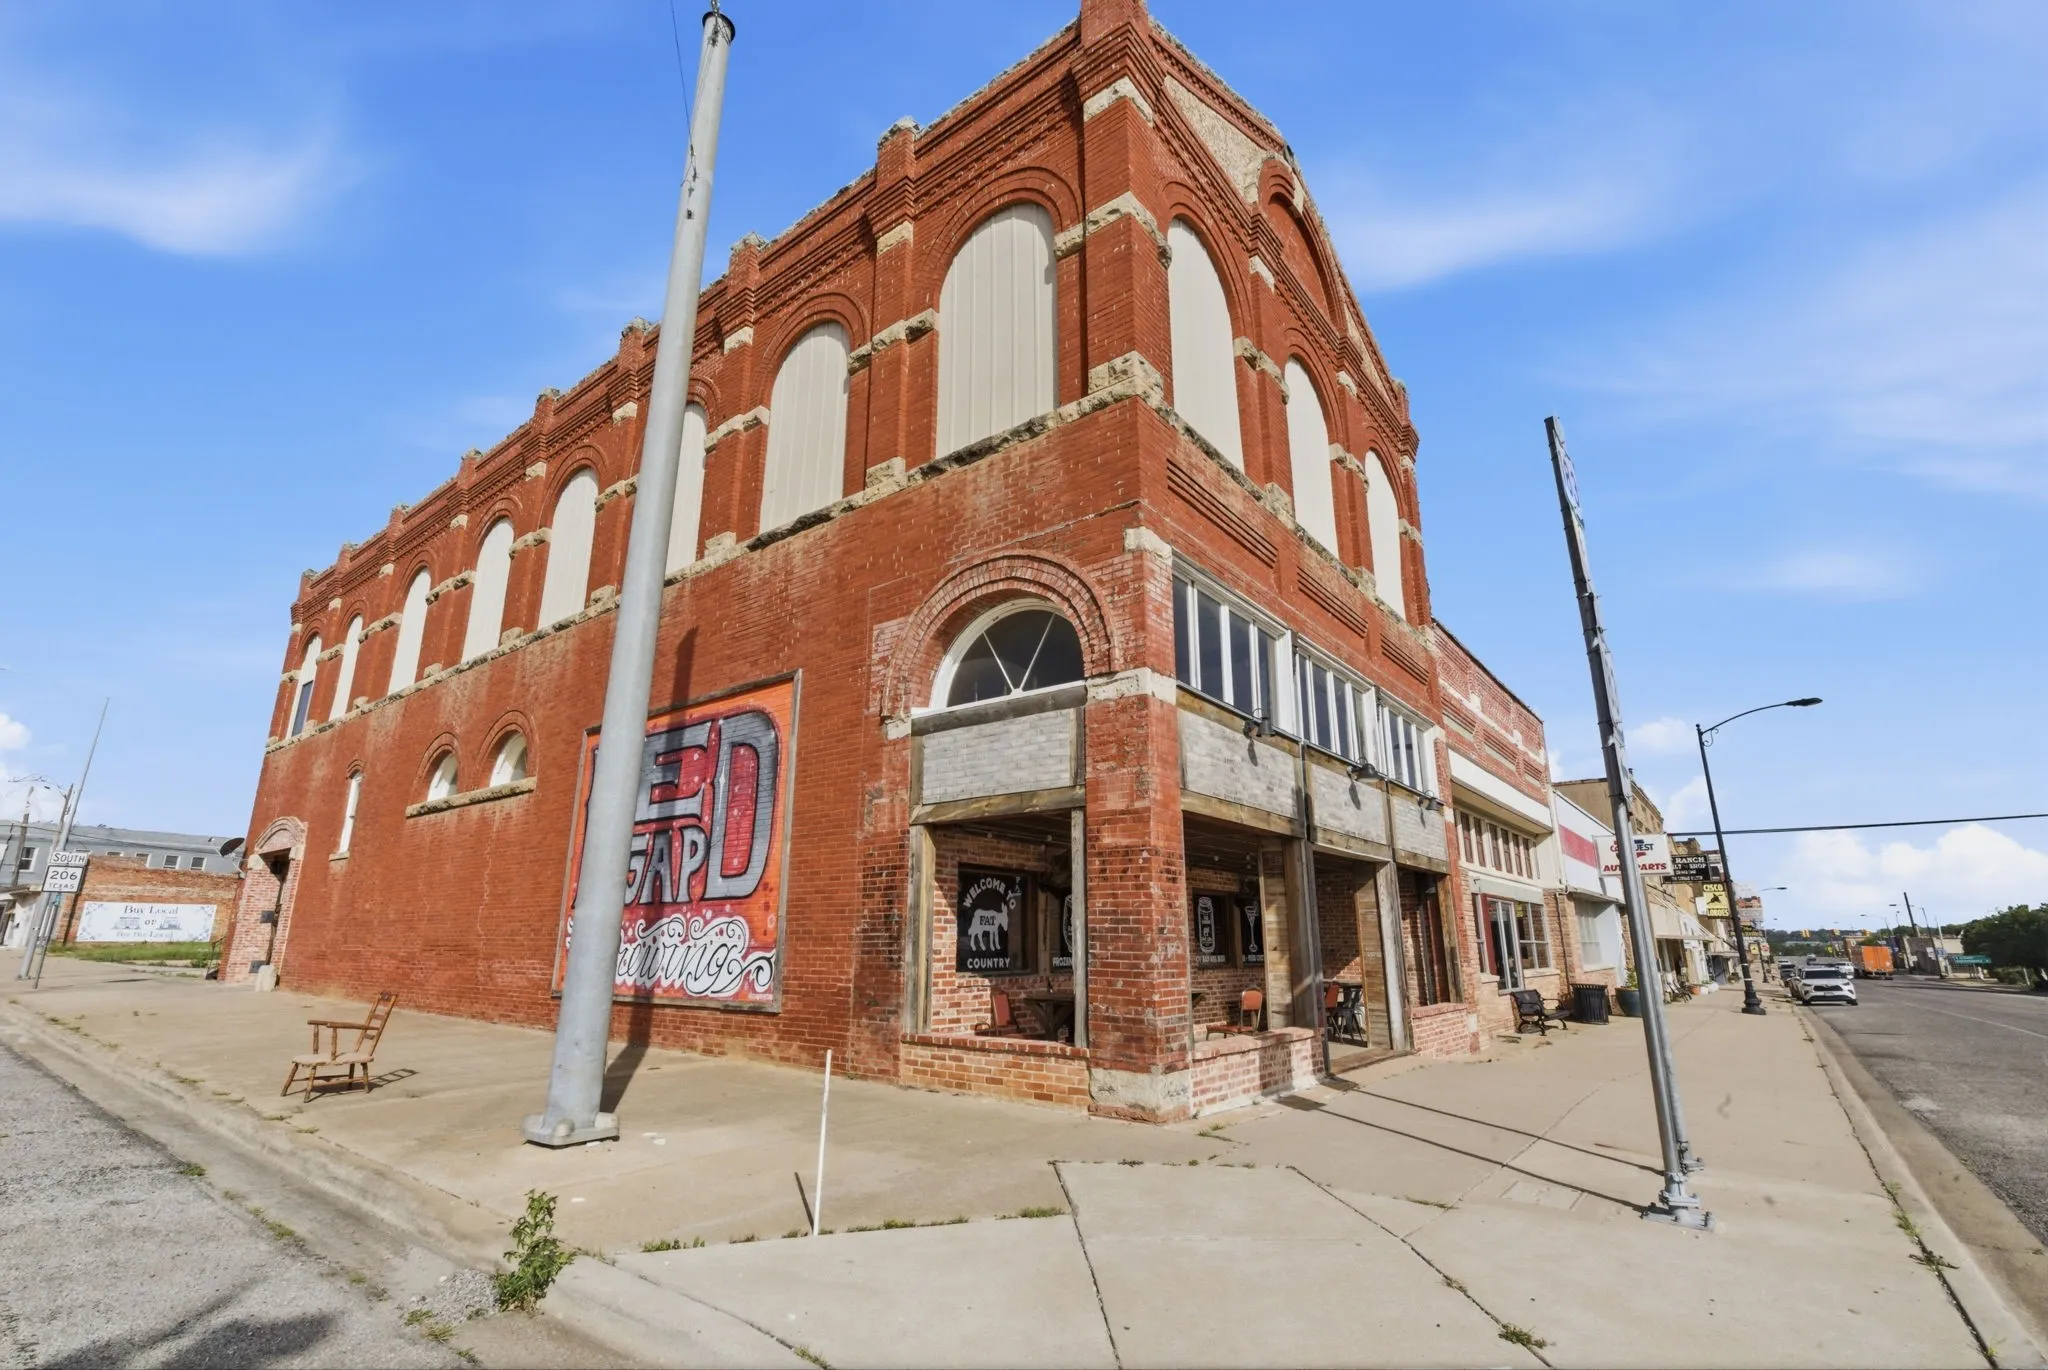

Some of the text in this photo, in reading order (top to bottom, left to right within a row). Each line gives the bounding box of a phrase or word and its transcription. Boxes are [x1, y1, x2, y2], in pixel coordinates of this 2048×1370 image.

[574, 709, 780, 905] ED
[53, 852, 86, 863] SOUTH
[1638, 862, 1667, 871] ARTS
[50, 870, 78, 880] 206
[49, 882, 76, 890] TEXAS
[963, 877, 1006, 908] WELCOME
[980, 915, 997, 926] FAT
[967, 958, 1010, 969] COUNTRY
